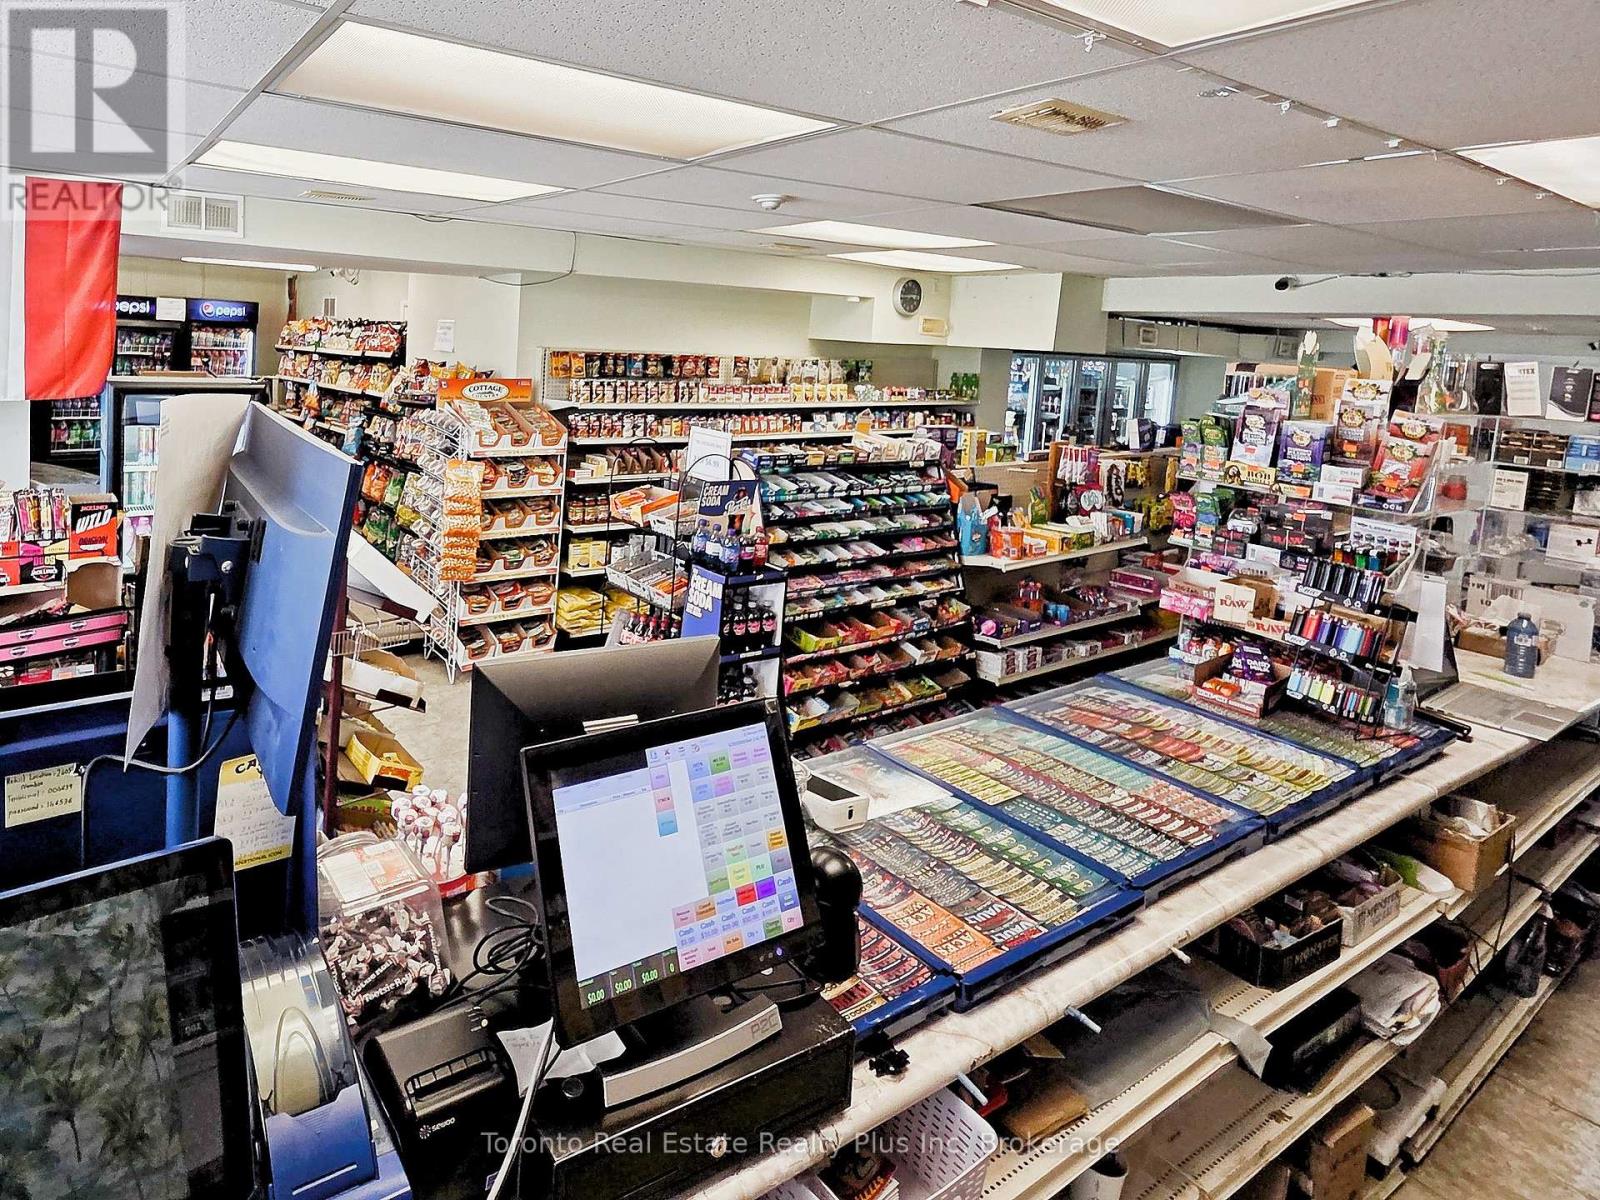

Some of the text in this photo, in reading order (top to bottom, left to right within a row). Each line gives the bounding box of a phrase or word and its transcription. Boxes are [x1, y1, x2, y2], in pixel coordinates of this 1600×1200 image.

[215, 305, 246, 317] pepsi
[468, 385, 502, 393] COTTAGE
[703, 485, 730, 497] CREAM
[700, 495, 721, 507] SODA
[690, 573, 723, 600] CREAM
[687, 586, 713, 612] SODA
[1219, 599, 1249, 609] RAW
[1255, 621, 1286, 635] RAW
[777, 876, 793, 887] Cash
[741, 905, 756, 915] Cash
[761, 899, 776, 909] Cash
[721, 912, 736, 922] Cash
[963, 903, 1006, 925] VAULT
[700, 920, 715, 930] Cash
[678, 927, 695, 937] Cash
[992, 920, 1034, 943] VAULT
[933, 931, 976, 956] ACES
[668, 962, 675, 973] 0
[641, 969, 658, 984] $0.00
[362, 971, 412, 1003] Tootsie Roll
[614, 979, 632, 994] $0.00
[587, 988, 605, 1005] $0.00
